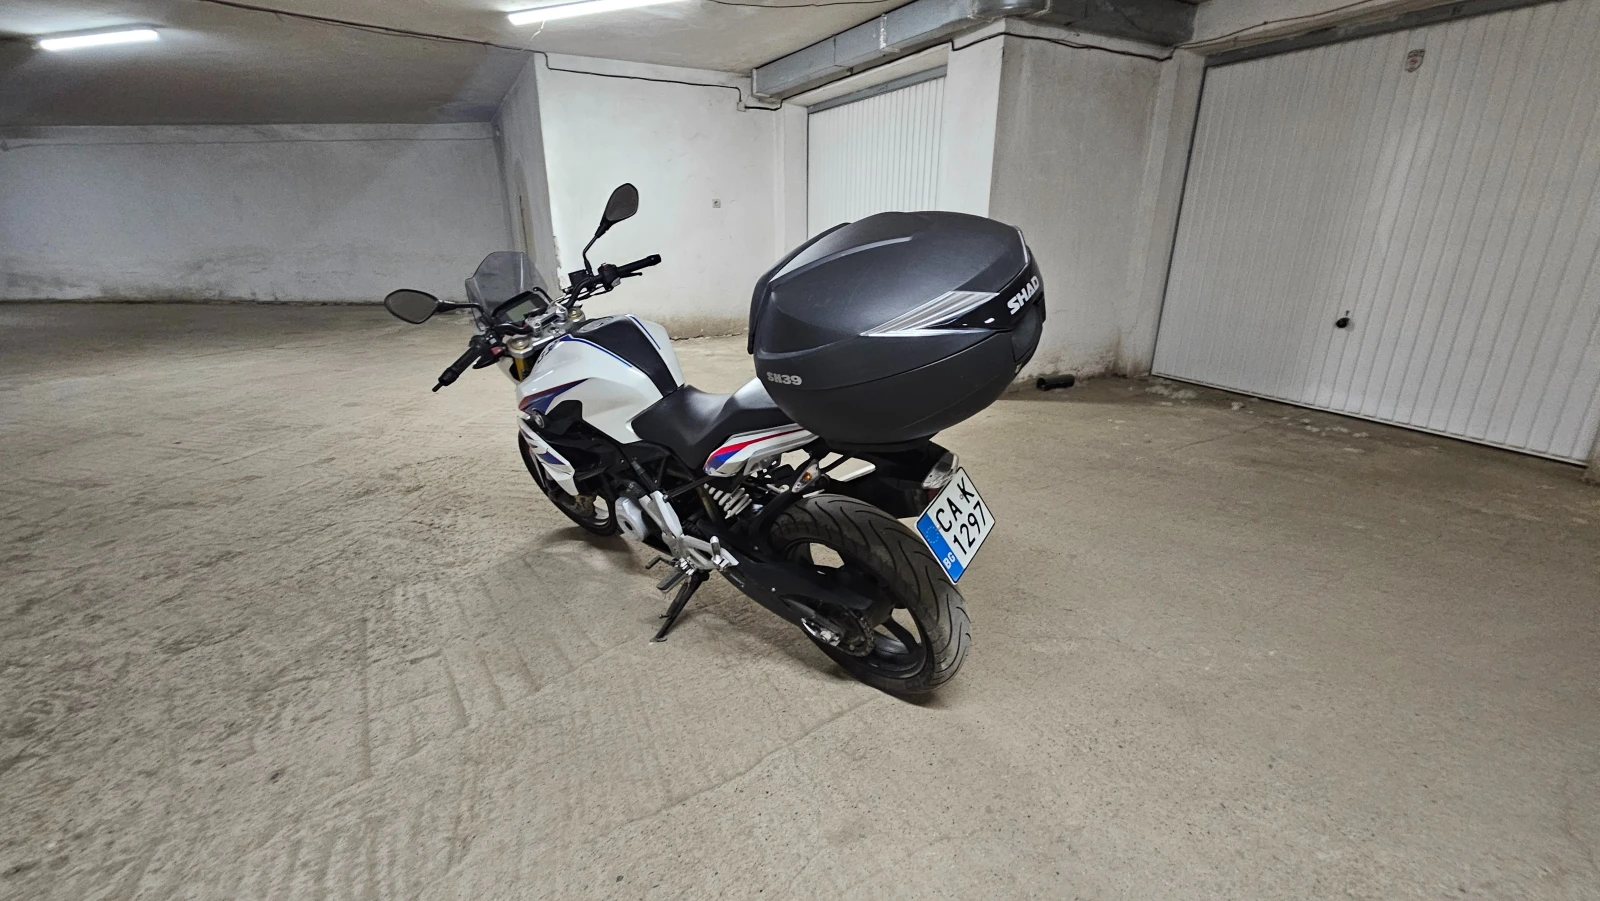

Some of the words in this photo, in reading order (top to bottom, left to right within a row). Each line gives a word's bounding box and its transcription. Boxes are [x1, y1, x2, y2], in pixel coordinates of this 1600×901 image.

[1007, 276, 1039, 315] SHAD
[766, 372, 802, 385] SH39
[936, 497, 963, 532] CA
[957, 477, 975, 503] K
[953, 500, 986, 555] 1297
[943, 552, 956, 569] BG
